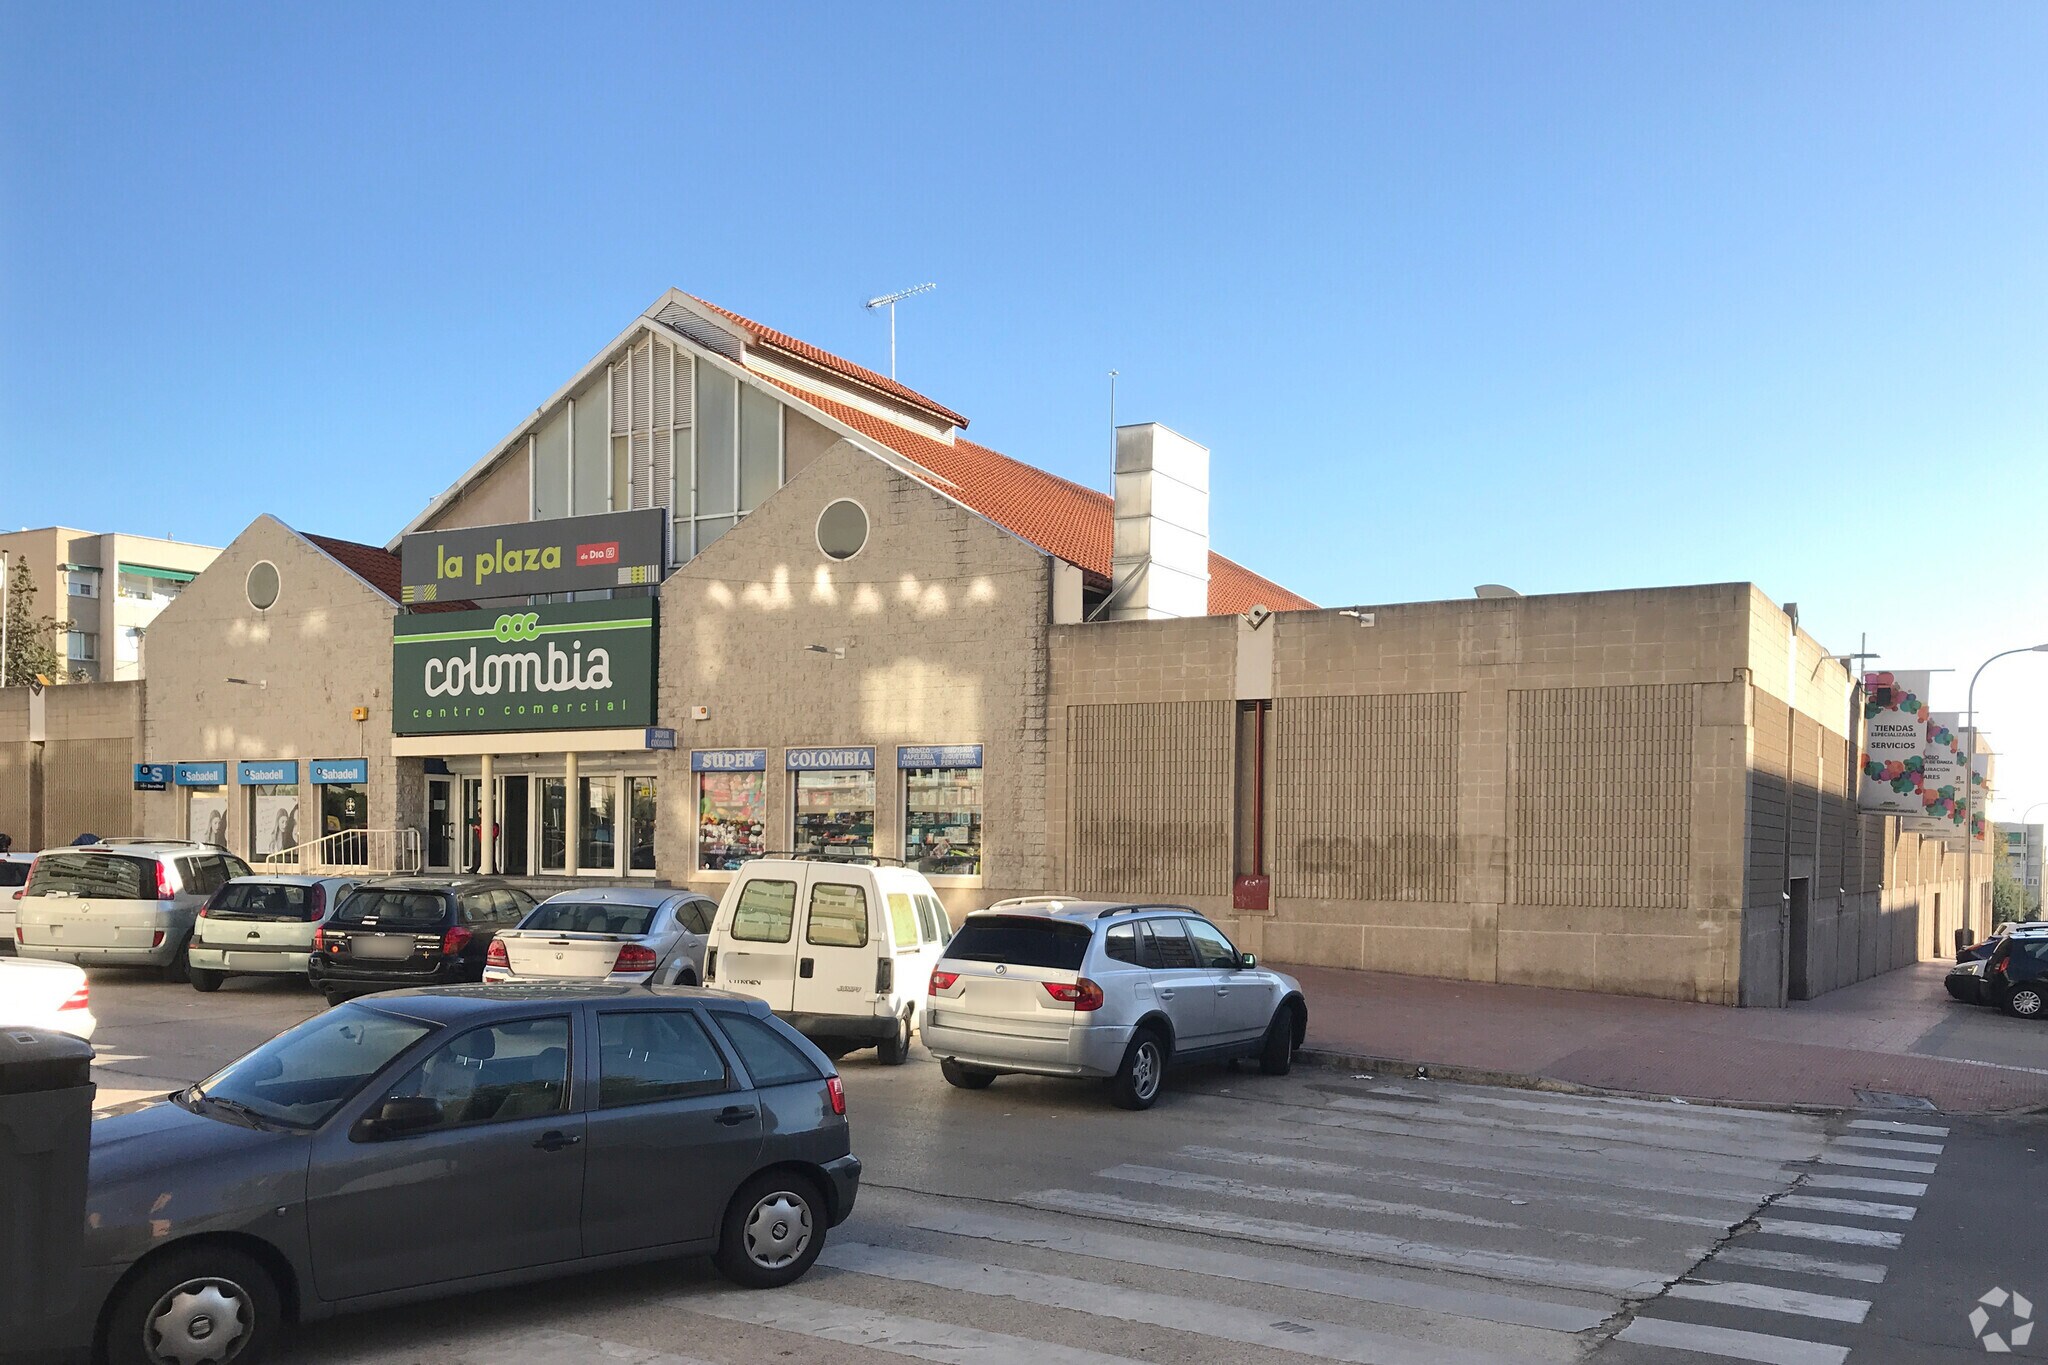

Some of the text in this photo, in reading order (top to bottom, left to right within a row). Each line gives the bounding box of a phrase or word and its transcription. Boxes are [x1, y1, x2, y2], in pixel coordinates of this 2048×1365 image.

[437, 538, 561, 585] la plaza
[424, 640, 613, 698] colombia
[412, 699, 626, 718] centro comercial
[654, 730, 670, 739] SUPER
[702, 751, 755, 769] SUPER
[788, 751, 872, 767] COLOMBIA
[151, 767, 163, 782] S
[186, 770, 218, 782] Sabadell
[250, 769, 283, 780] Sabadell
[322, 768, 358, 779] Sabadell
